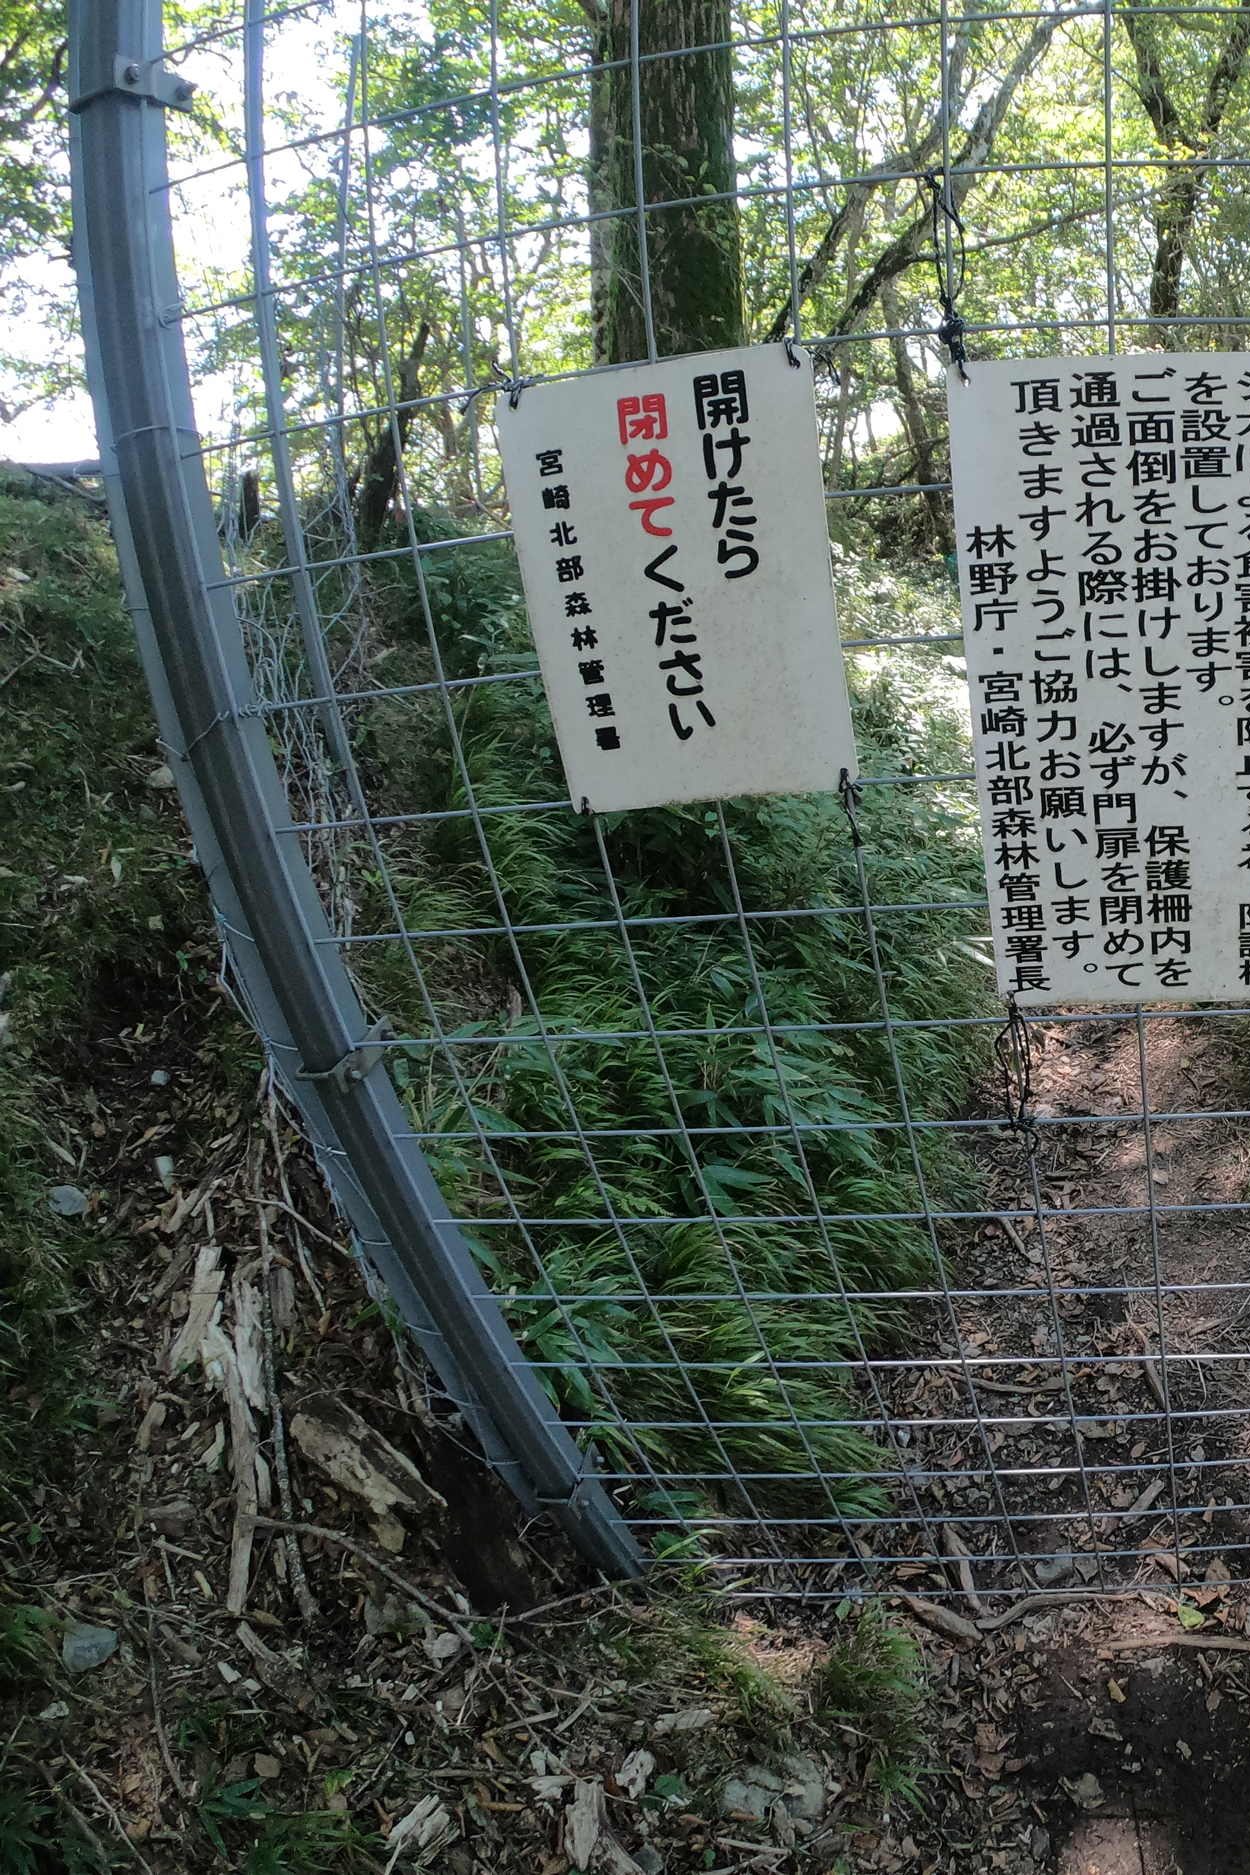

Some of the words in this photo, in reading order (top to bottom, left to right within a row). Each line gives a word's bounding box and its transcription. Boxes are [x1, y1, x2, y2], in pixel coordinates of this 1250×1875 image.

[617, 393, 716, 740] 閉めてください
[693, 370, 759, 579] 開けたら
[1010, 378, 1098, 974] 頂きますようご協力お願いします。
[1069, 371, 1145, 987] 通過される際には、必ず門扉を閉めて
[1126, 367, 1193, 987] ご面倒をお掛けしますが、保護柵内を
[1179, 372, 1235, 707] を設置しております。
[966, 525, 1051, 993] 林野庁・宮崎北部森林管理署長
